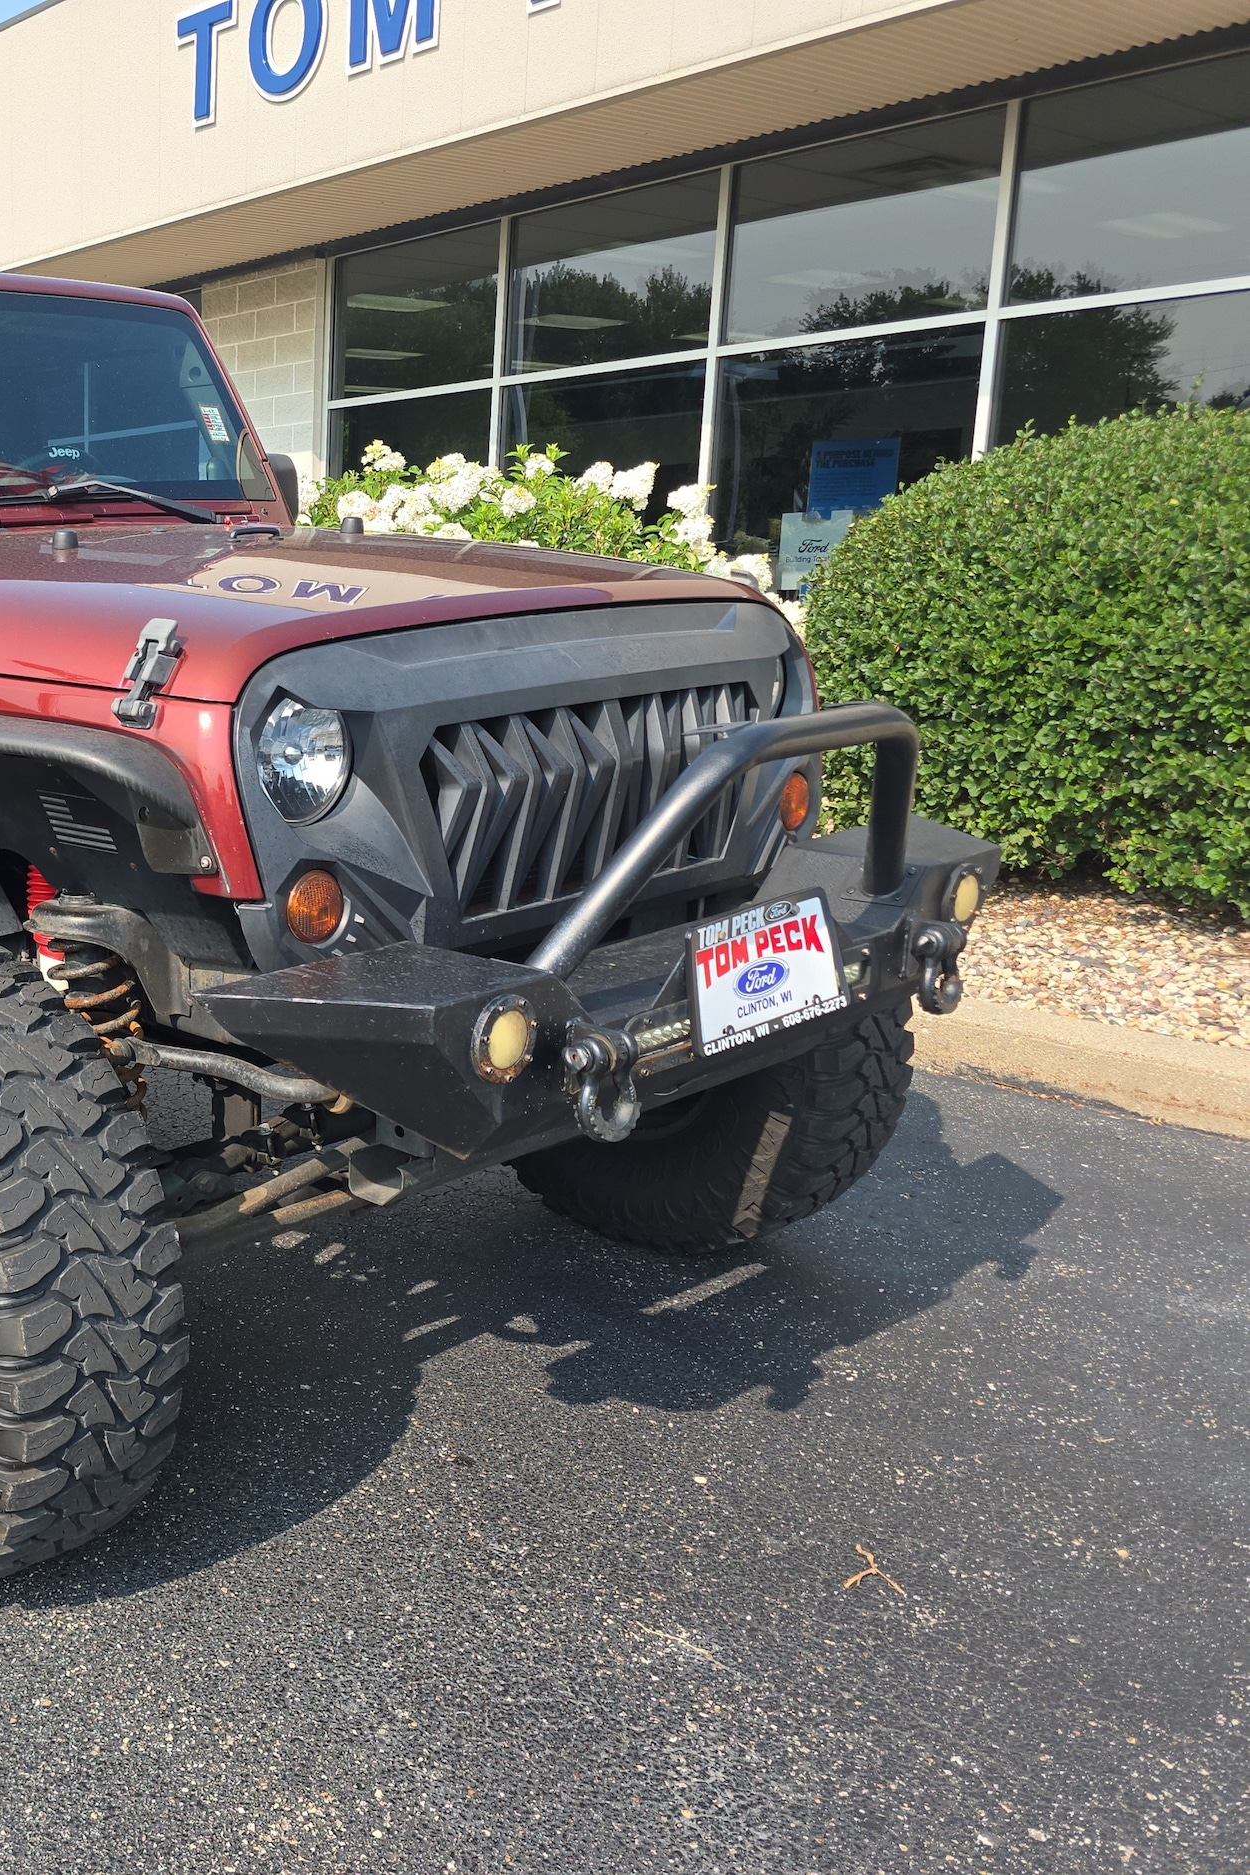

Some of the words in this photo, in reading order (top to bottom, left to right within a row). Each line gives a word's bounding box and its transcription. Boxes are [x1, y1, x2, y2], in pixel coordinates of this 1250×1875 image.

[176, 0, 441, 127] TOM
[48, 447, 80, 459] Jeep
[831, 458, 875, 468] PURCHASE
[798, 539, 829, 553] Ford
[698, 919, 729, 949] TOM
[732, 906, 765, 937] PECK
[769, 904, 788, 918] Ford
[696, 936, 749, 989] TOM
[755, 914, 825, 958] PECK
[745, 964, 777, 993] Ford
[737, 996, 778, 1018] CLINTON,
[780, 990, 792, 1003] WI
[703, 1029, 755, 1056] CLINTON,
[755, 1023, 770, 1037] WI
[782, 995, 847, 1028] 608-676-2273
